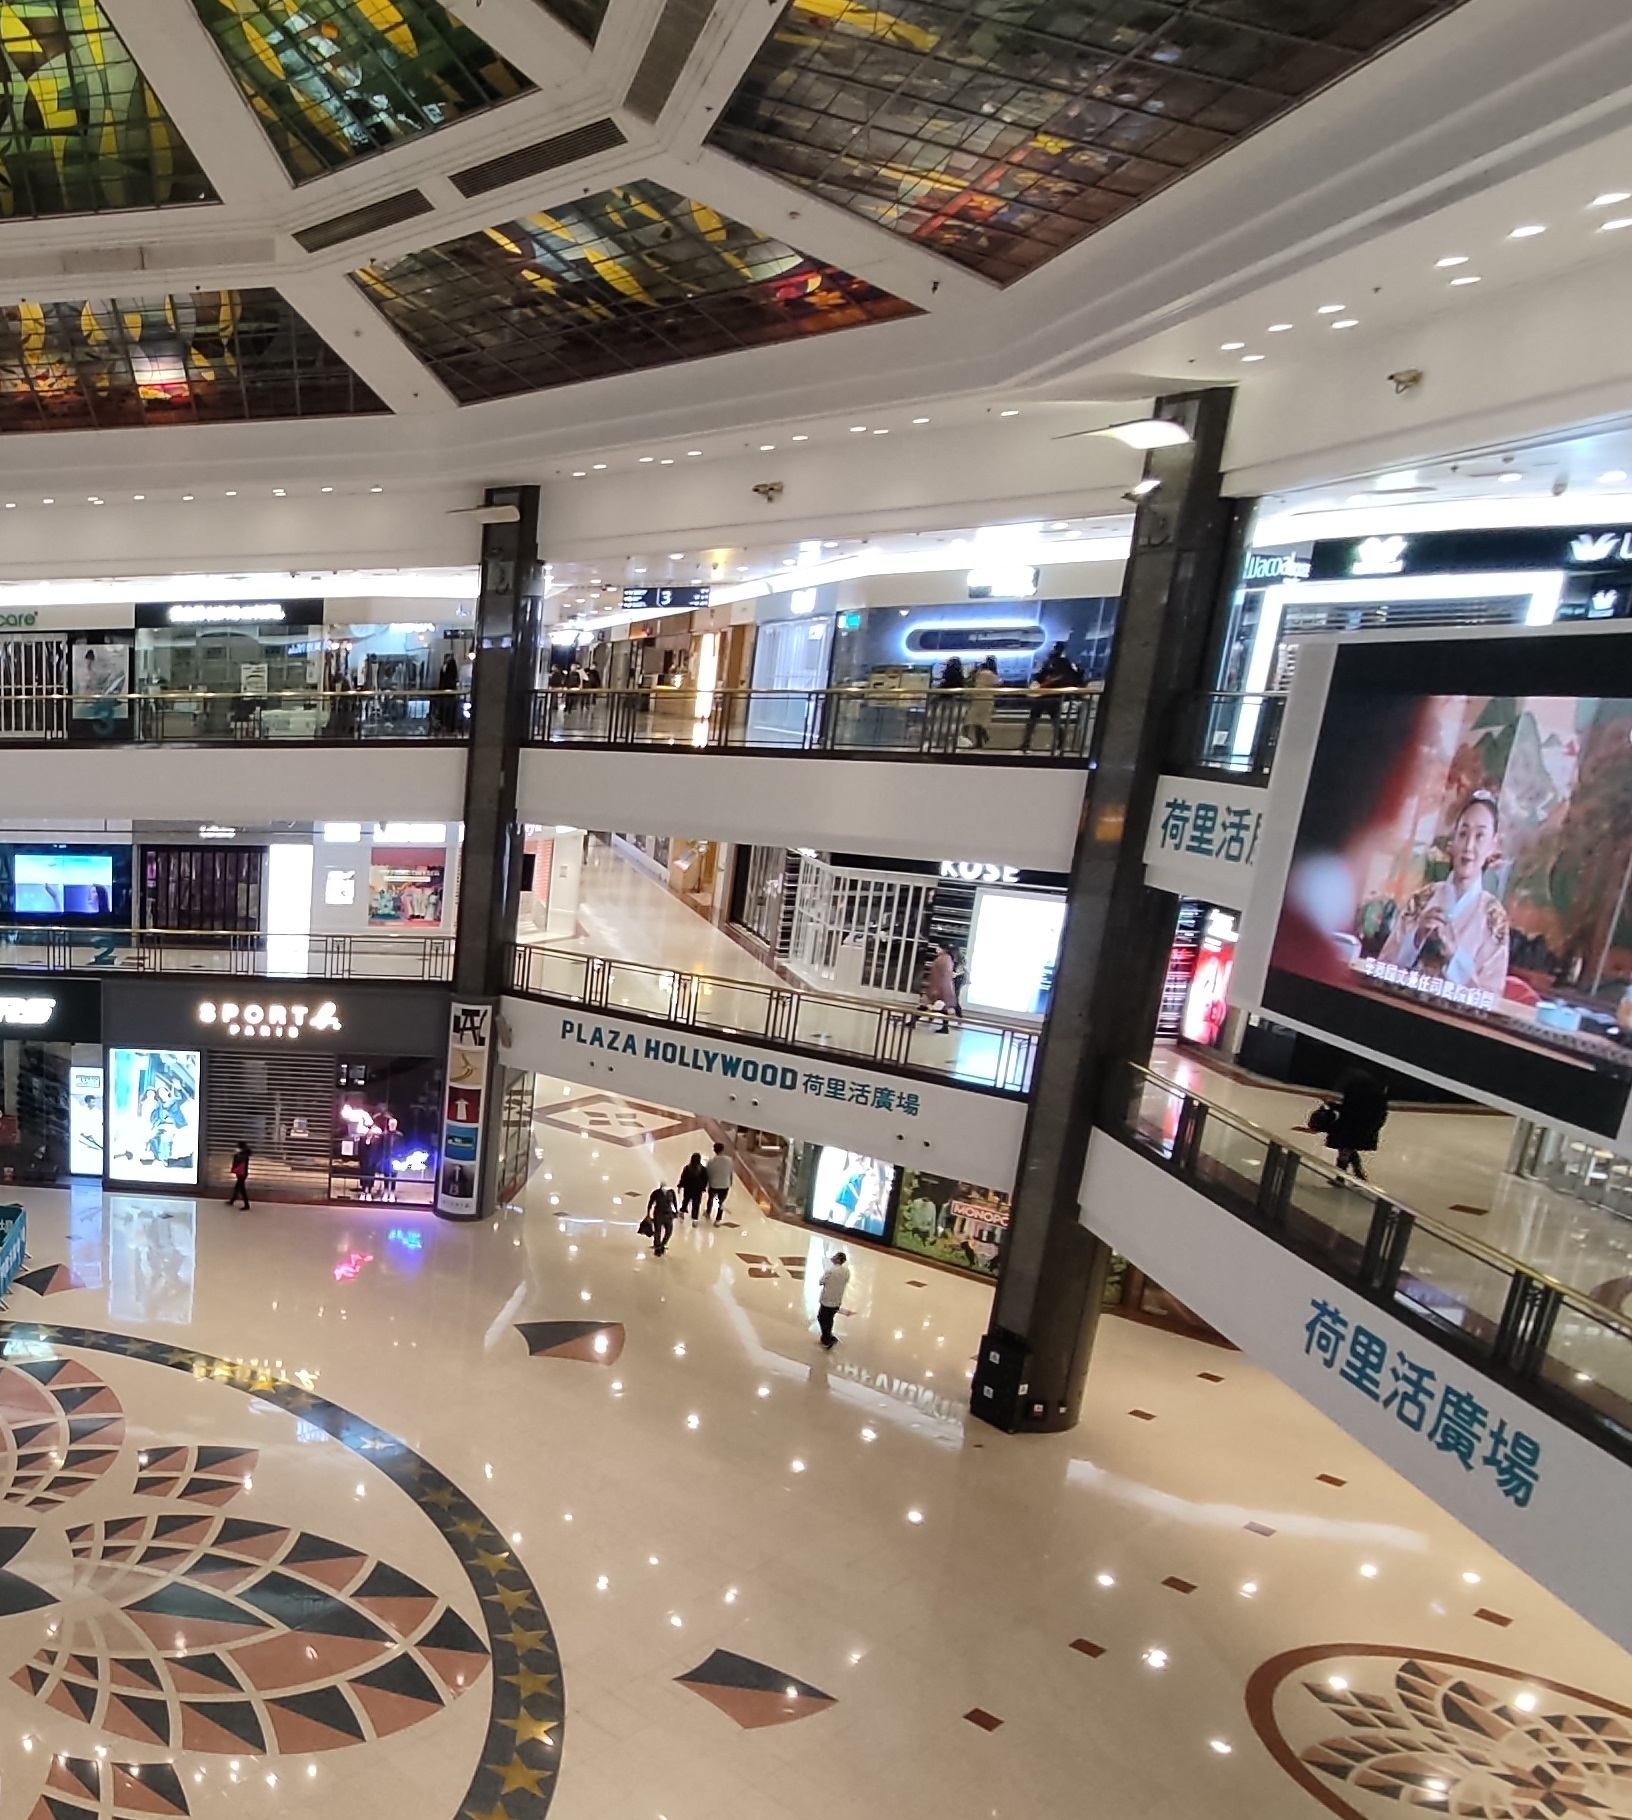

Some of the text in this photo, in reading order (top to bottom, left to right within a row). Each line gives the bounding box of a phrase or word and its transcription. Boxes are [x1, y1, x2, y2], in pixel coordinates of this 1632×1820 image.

[1243, 551, 1296, 579] Wacoal
[1160, 797, 1262, 867] 荷里活
[199, 1002, 309, 1027] SPORT
[229, 1024, 299, 1038] PARIS
[561, 1020, 920, 1116] PLAZA HOLLYWOOD 荷里活廣場
[1304, 1298, 1541, 1507] 荷里活廣場
